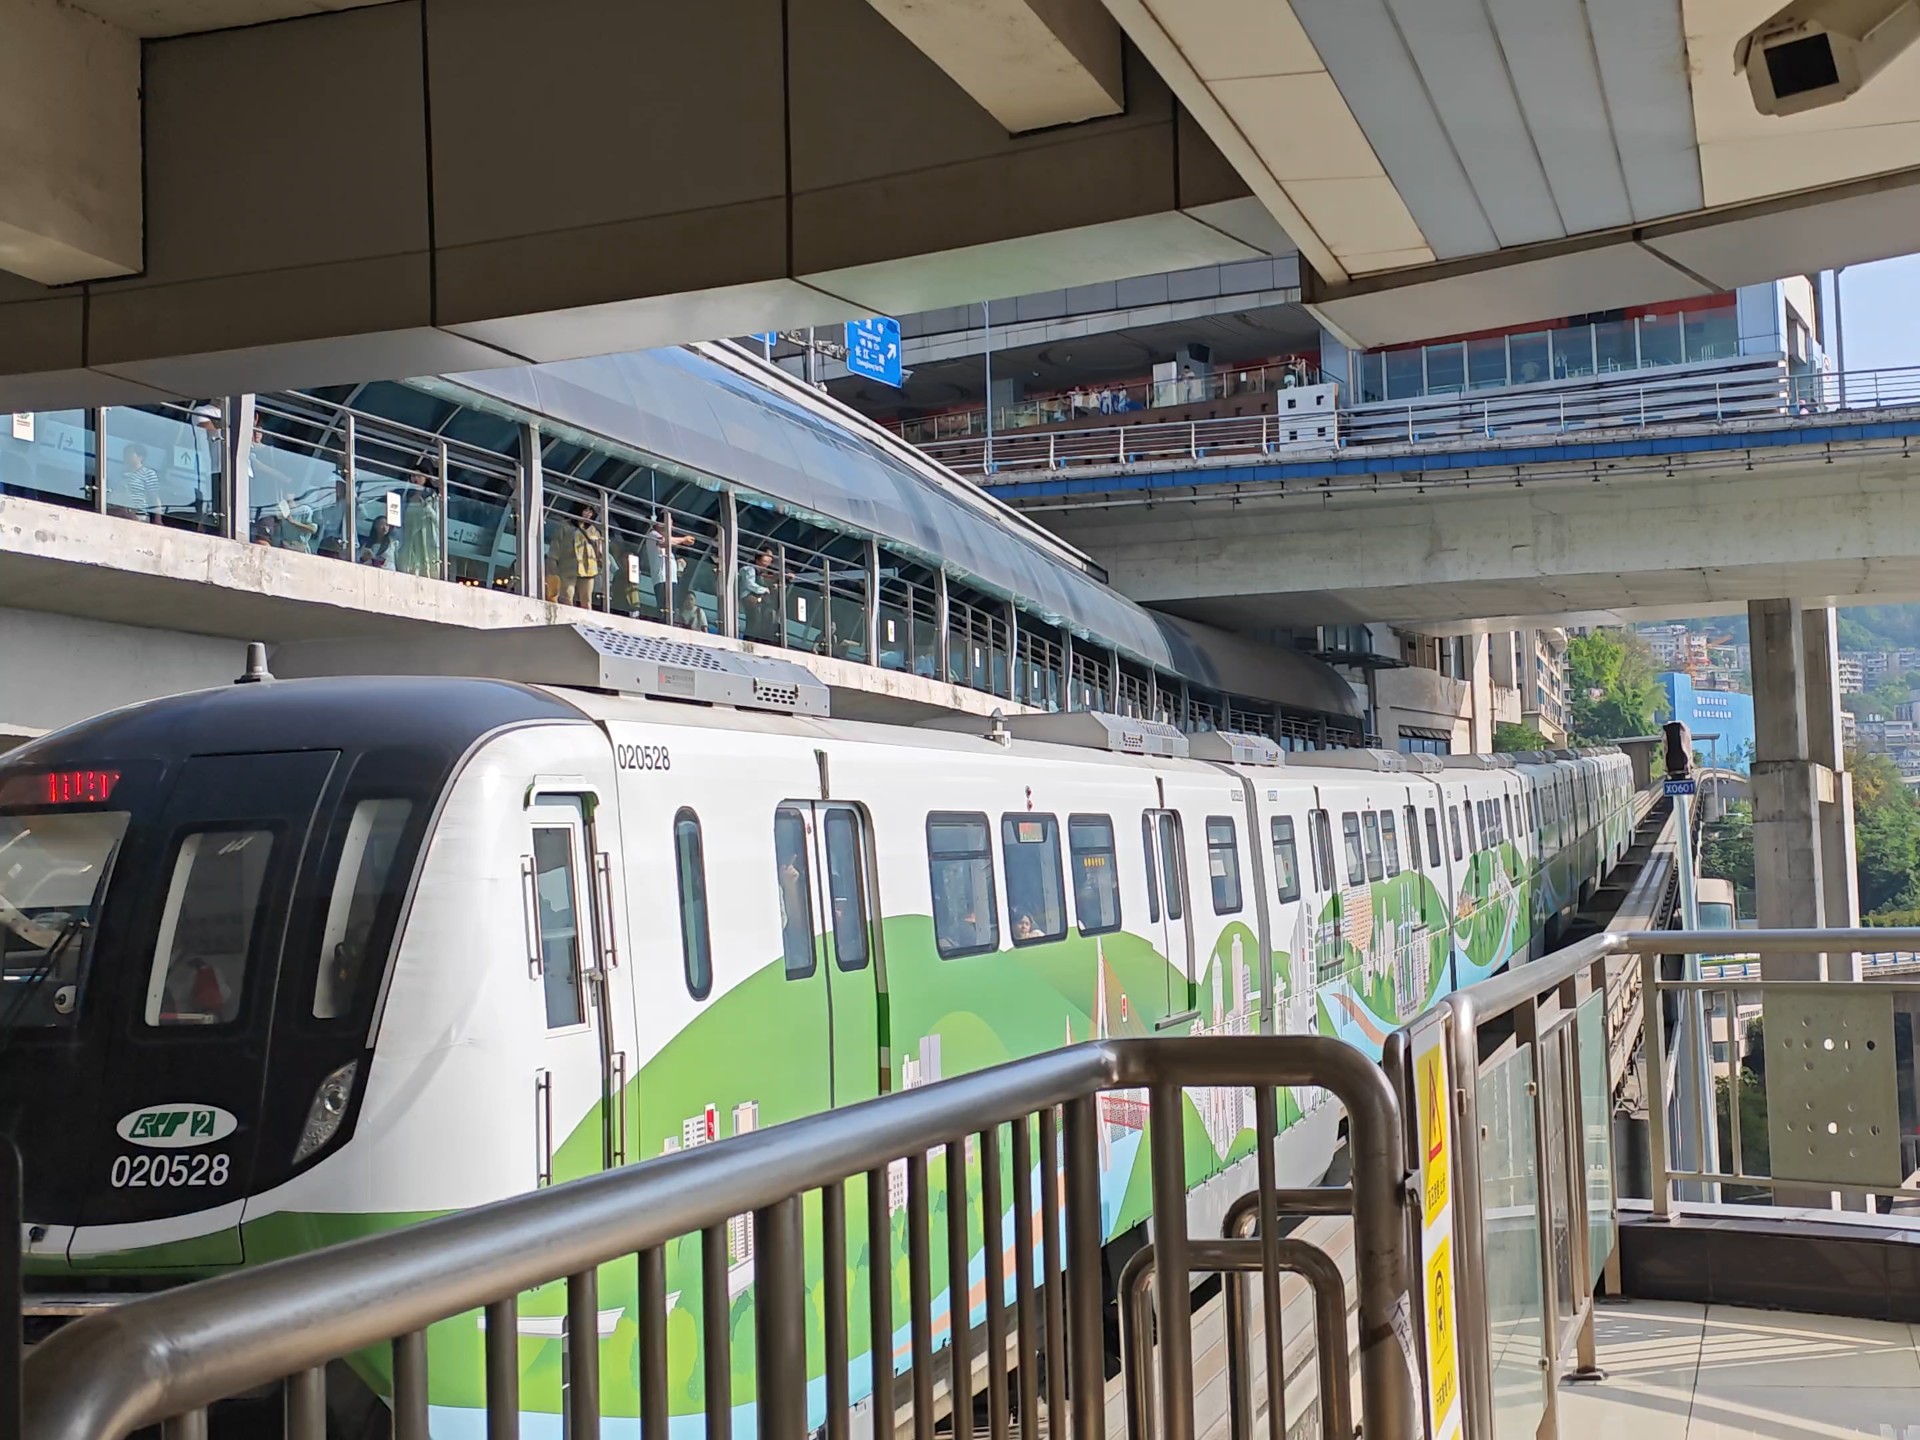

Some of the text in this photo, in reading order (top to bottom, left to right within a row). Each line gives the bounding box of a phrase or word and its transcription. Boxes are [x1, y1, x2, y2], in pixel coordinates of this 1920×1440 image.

[617, 743, 671, 770] 020528
[1665, 783, 1694, 794] X0601
[111, 1153, 230, 1187] 020528
